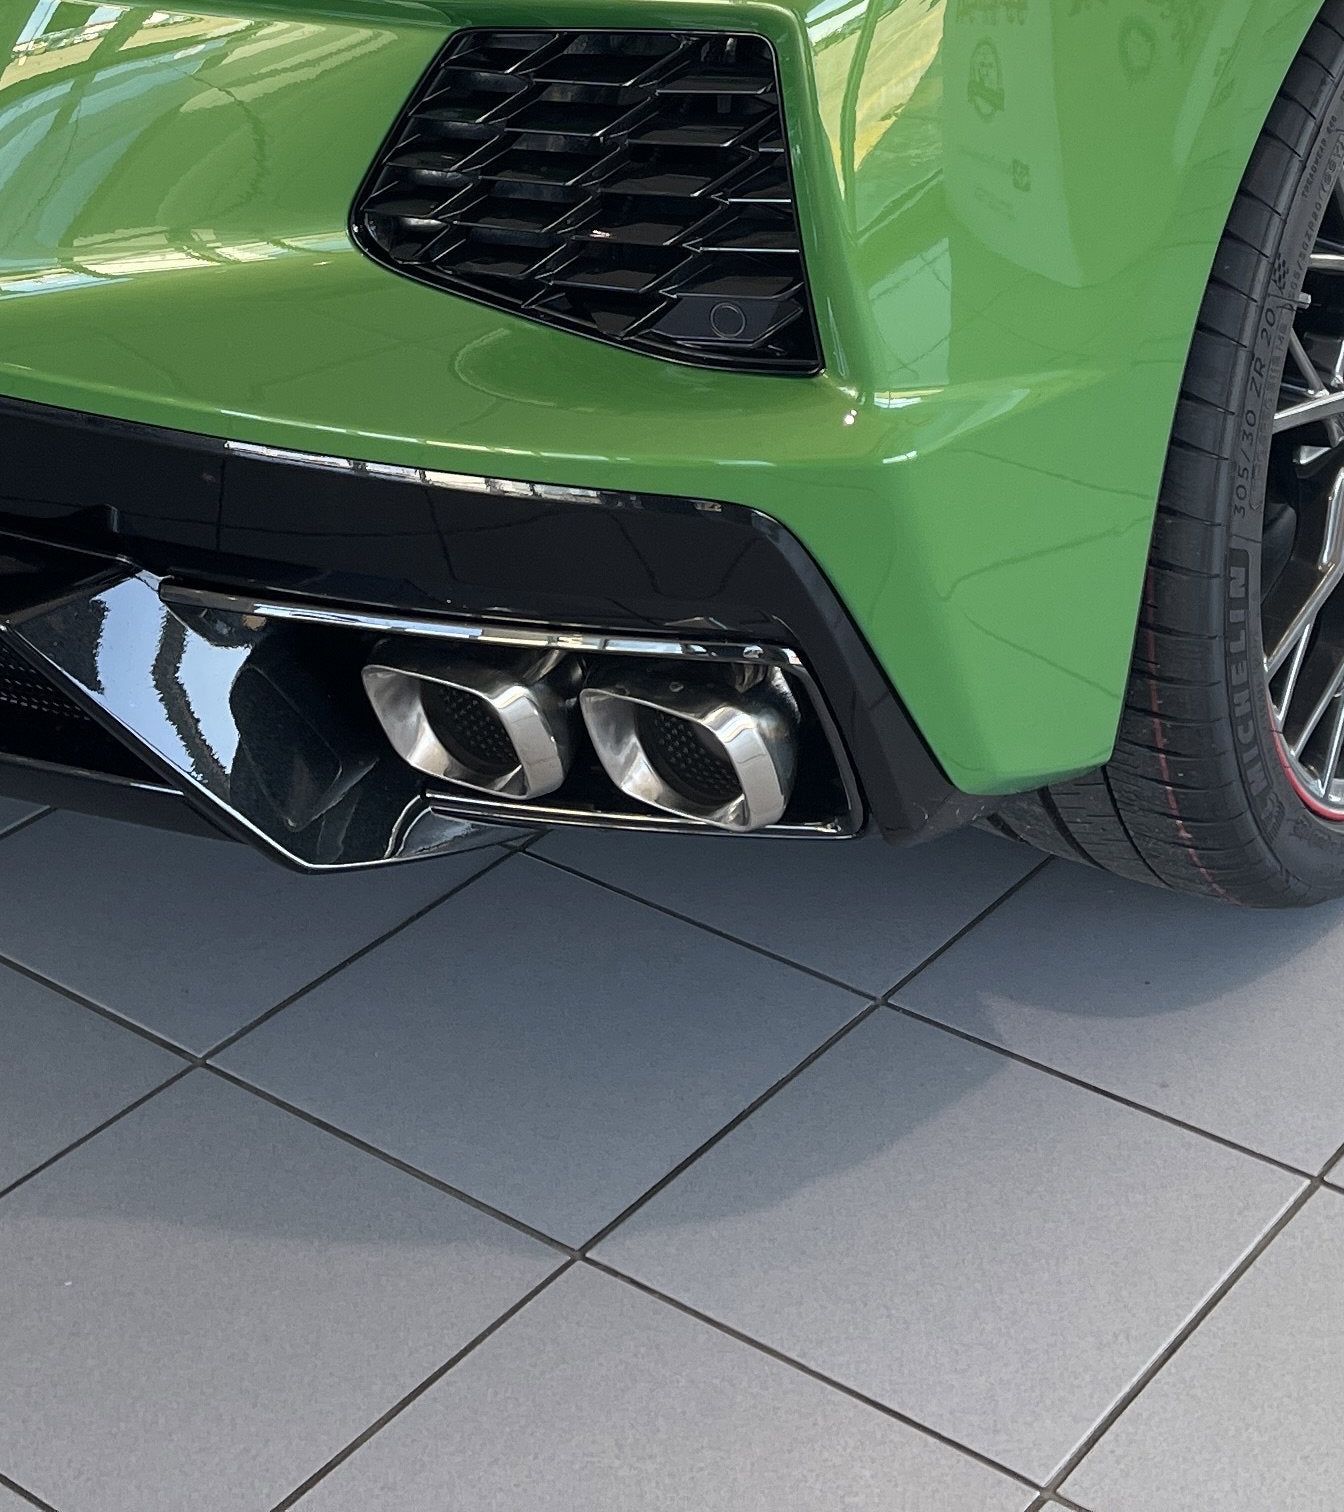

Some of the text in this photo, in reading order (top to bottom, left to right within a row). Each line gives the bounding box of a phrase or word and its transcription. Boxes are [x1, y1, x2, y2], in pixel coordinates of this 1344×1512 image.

[1233, 307, 1276, 519] 305/30 ZR 20
[1227, 567, 1268, 796] MICHELIN
